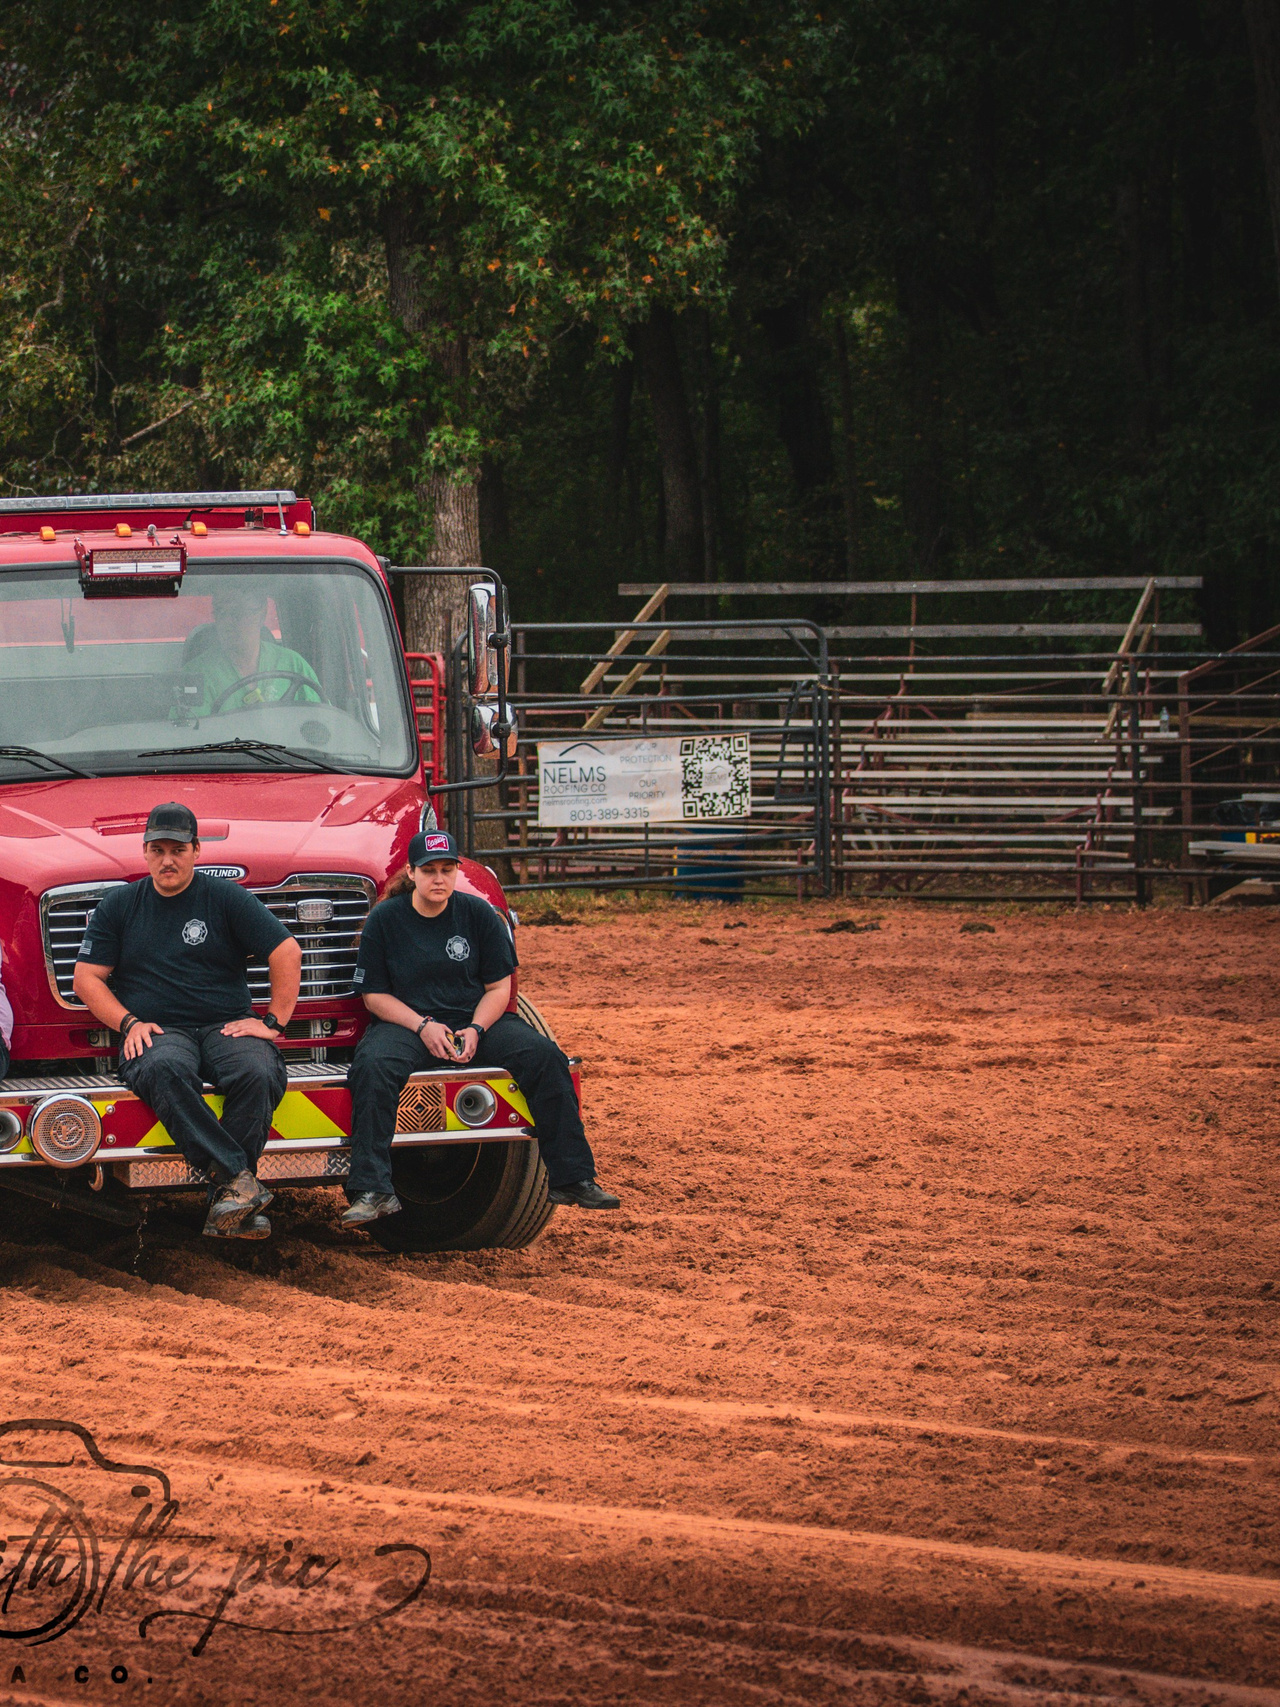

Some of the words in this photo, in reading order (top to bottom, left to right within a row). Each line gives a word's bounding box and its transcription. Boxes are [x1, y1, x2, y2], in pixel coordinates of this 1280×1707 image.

[635, 743, 657, 751] YOUR
[620, 754, 672, 764] PROTECTION
[543, 766, 606, 784] NELMS
[639, 779, 657, 787] OUR
[543, 784, 588, 795] ROOFING
[590, 783, 606, 793] CO
[628, 790, 666, 799] PRIORITY
[542, 797, 608, 806] nelmsroofing.com
[570, 807, 650, 821] 803-389-3315
